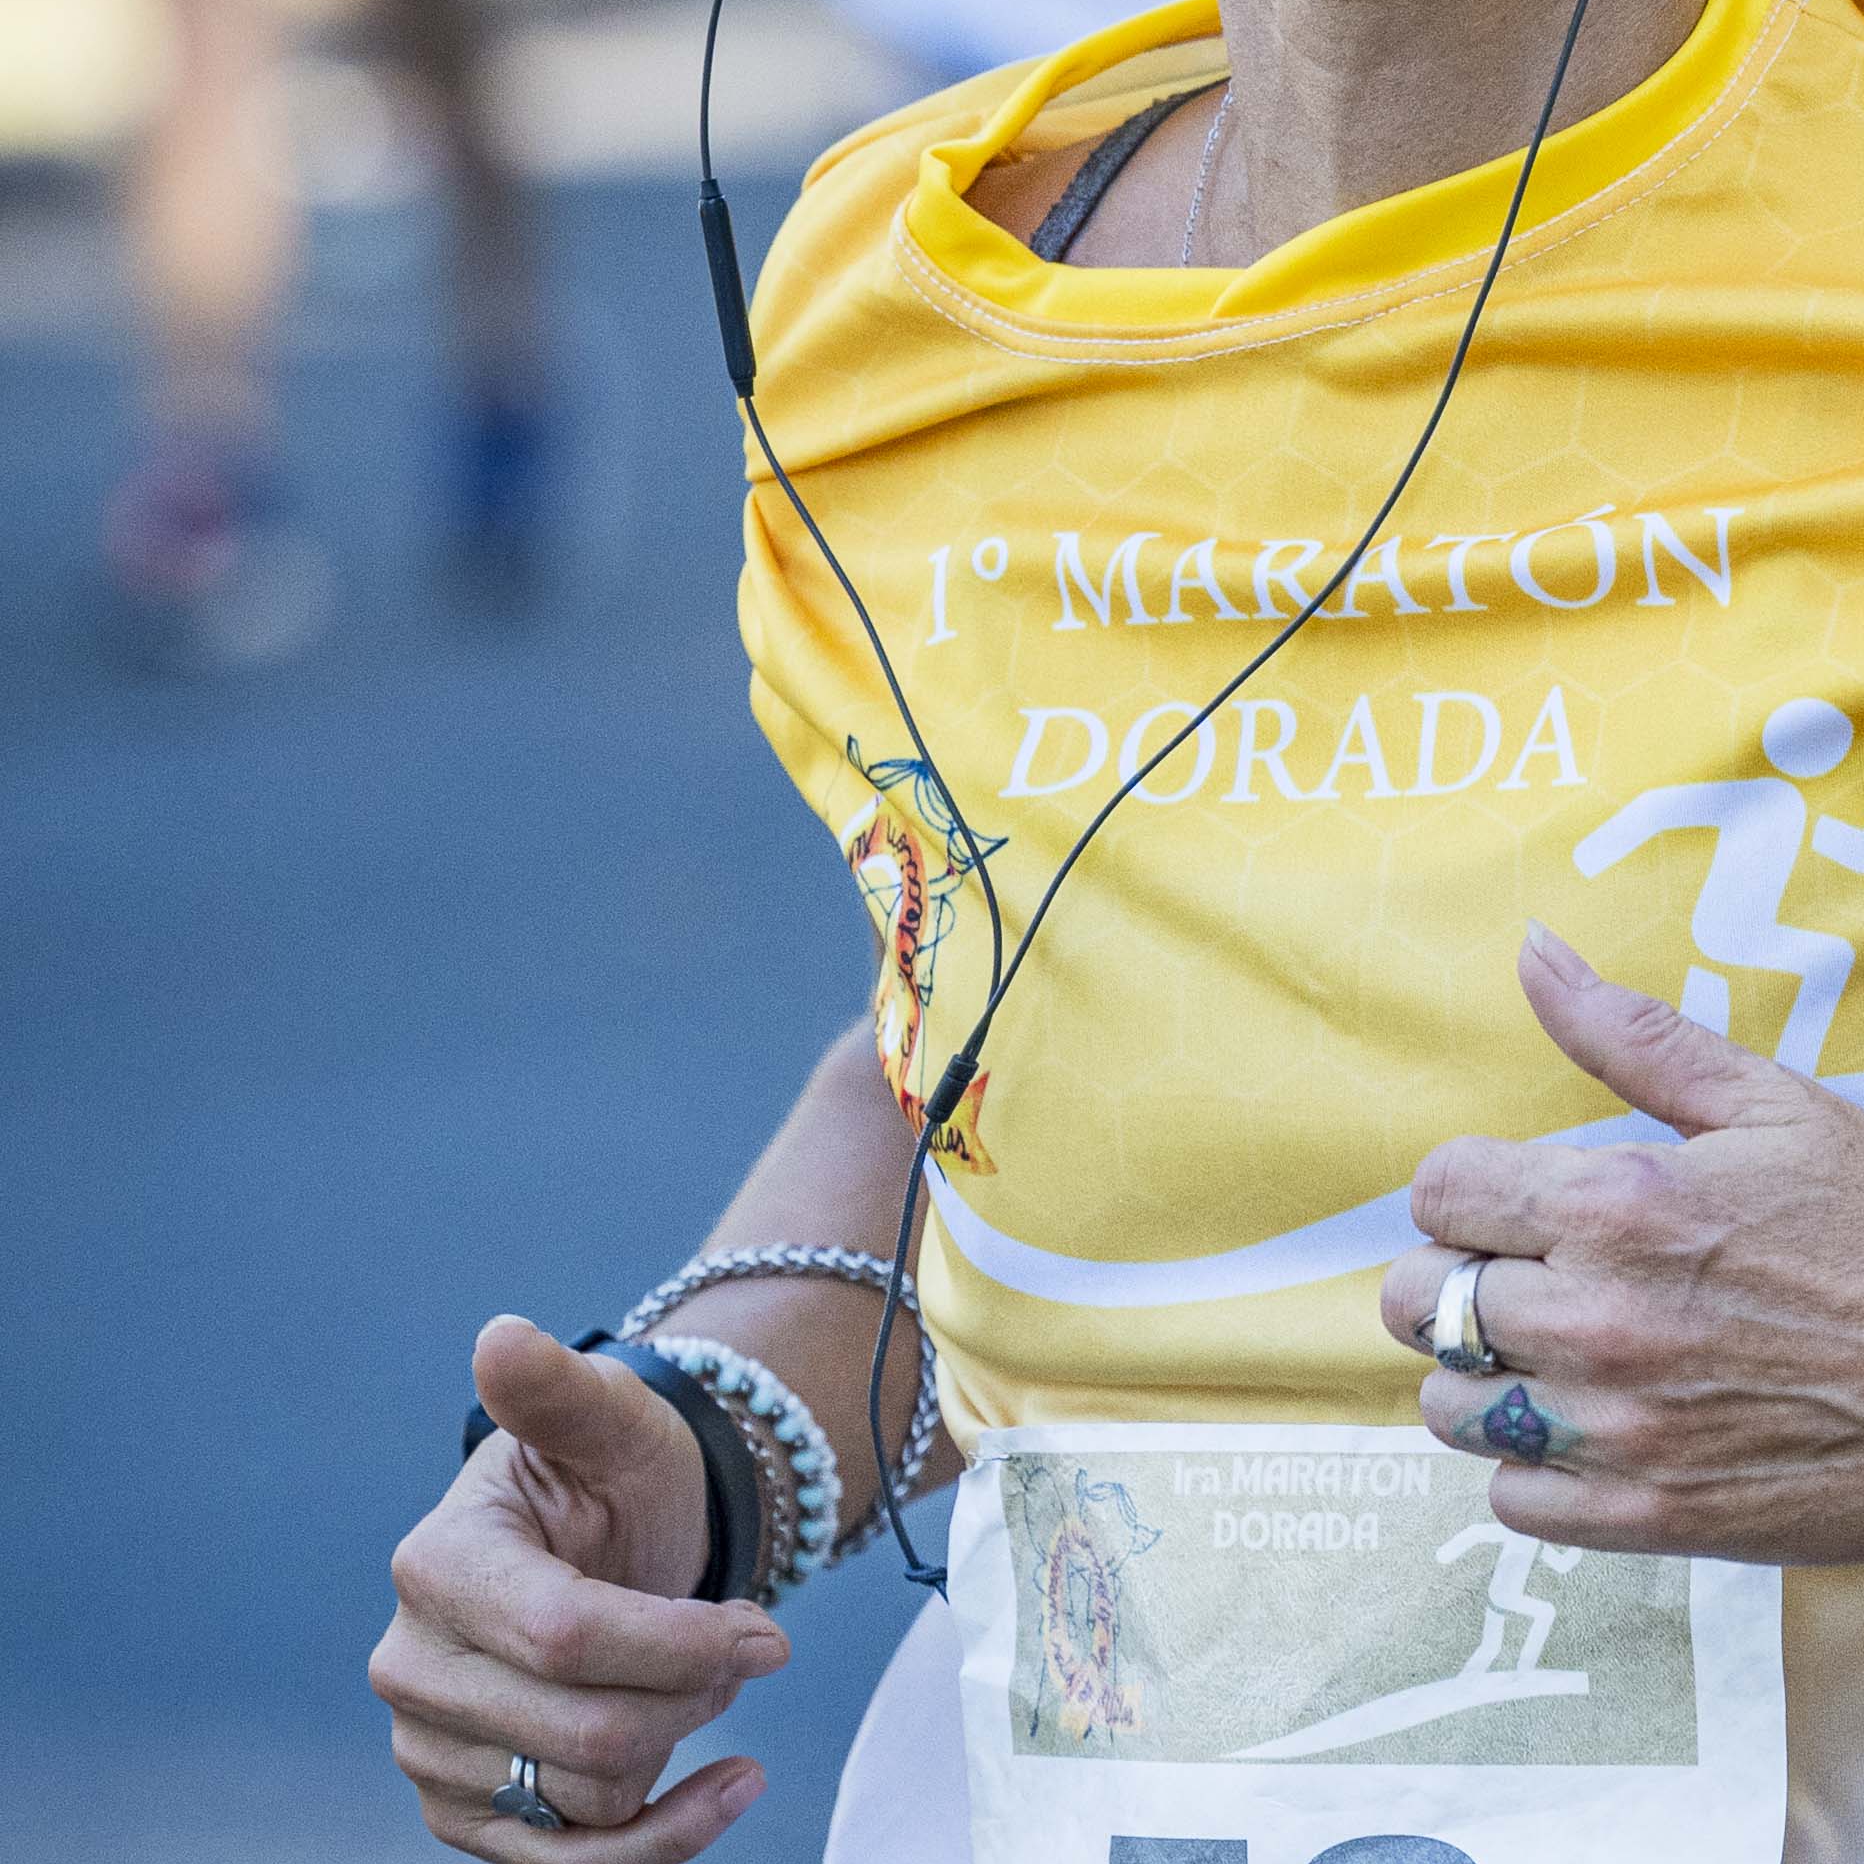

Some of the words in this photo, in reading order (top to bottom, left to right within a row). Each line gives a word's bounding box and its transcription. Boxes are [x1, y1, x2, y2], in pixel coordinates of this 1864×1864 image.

[1051, 503, 1746, 632] MARATÓN
[998, 683, 1588, 806] DORADA
[1230, 1453, 1432, 1499] MARATON
[1211, 1509, 1379, 1552] DORADA
